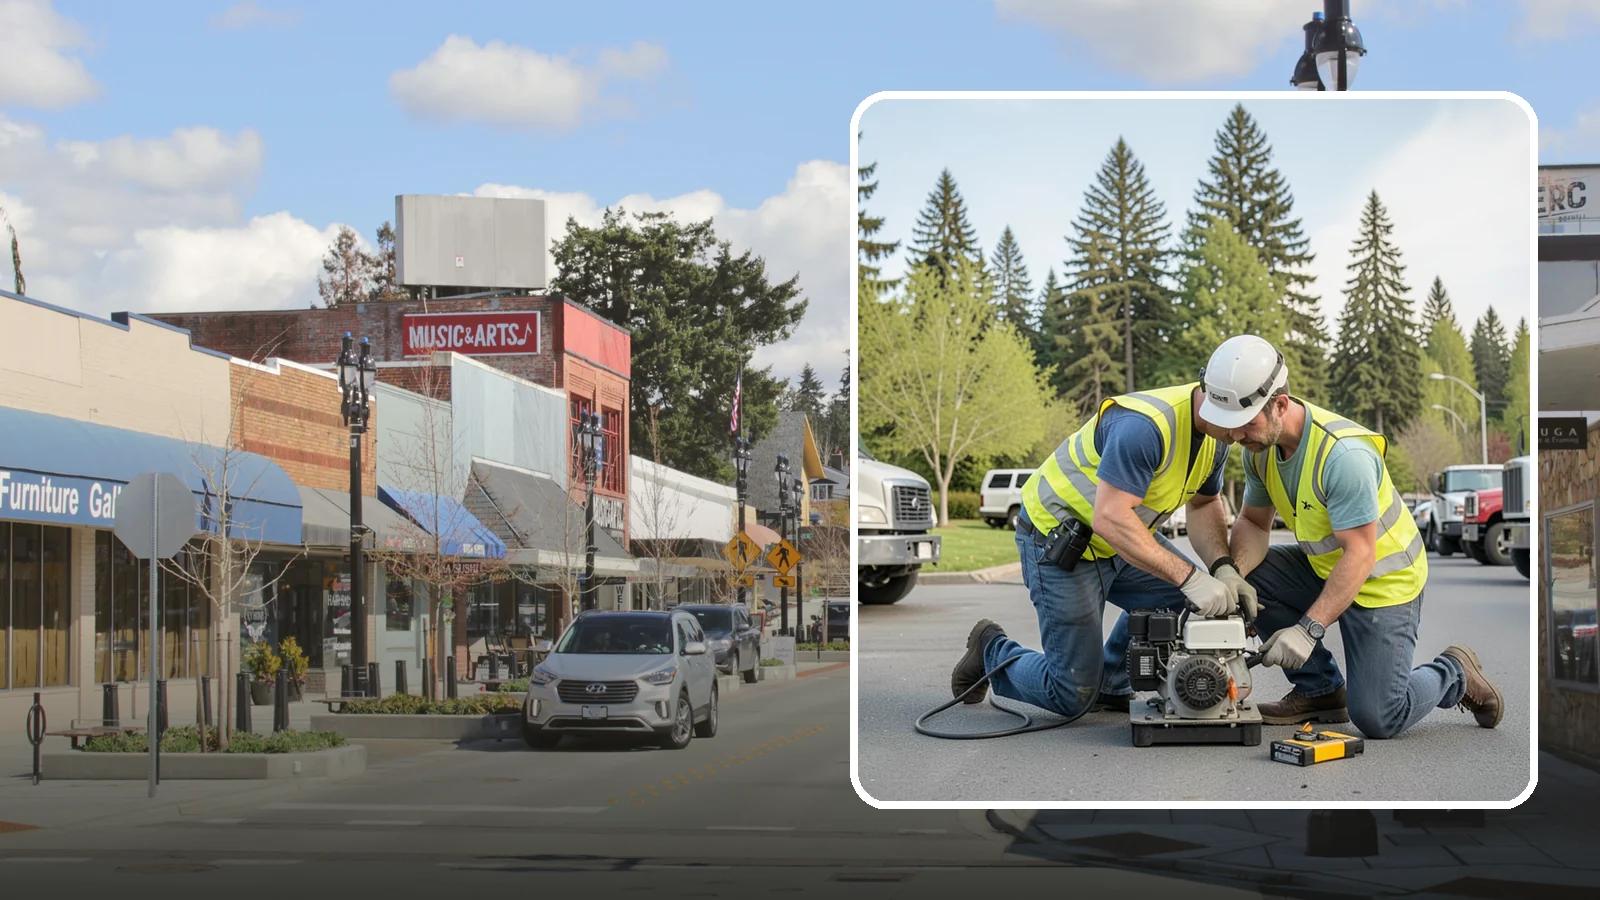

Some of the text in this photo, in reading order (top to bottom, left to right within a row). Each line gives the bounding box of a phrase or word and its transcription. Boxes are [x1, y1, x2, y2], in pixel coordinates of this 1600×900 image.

[1540, 427, 1577, 437] UGA
[0, 471, 121, 519] Furniture Gal
